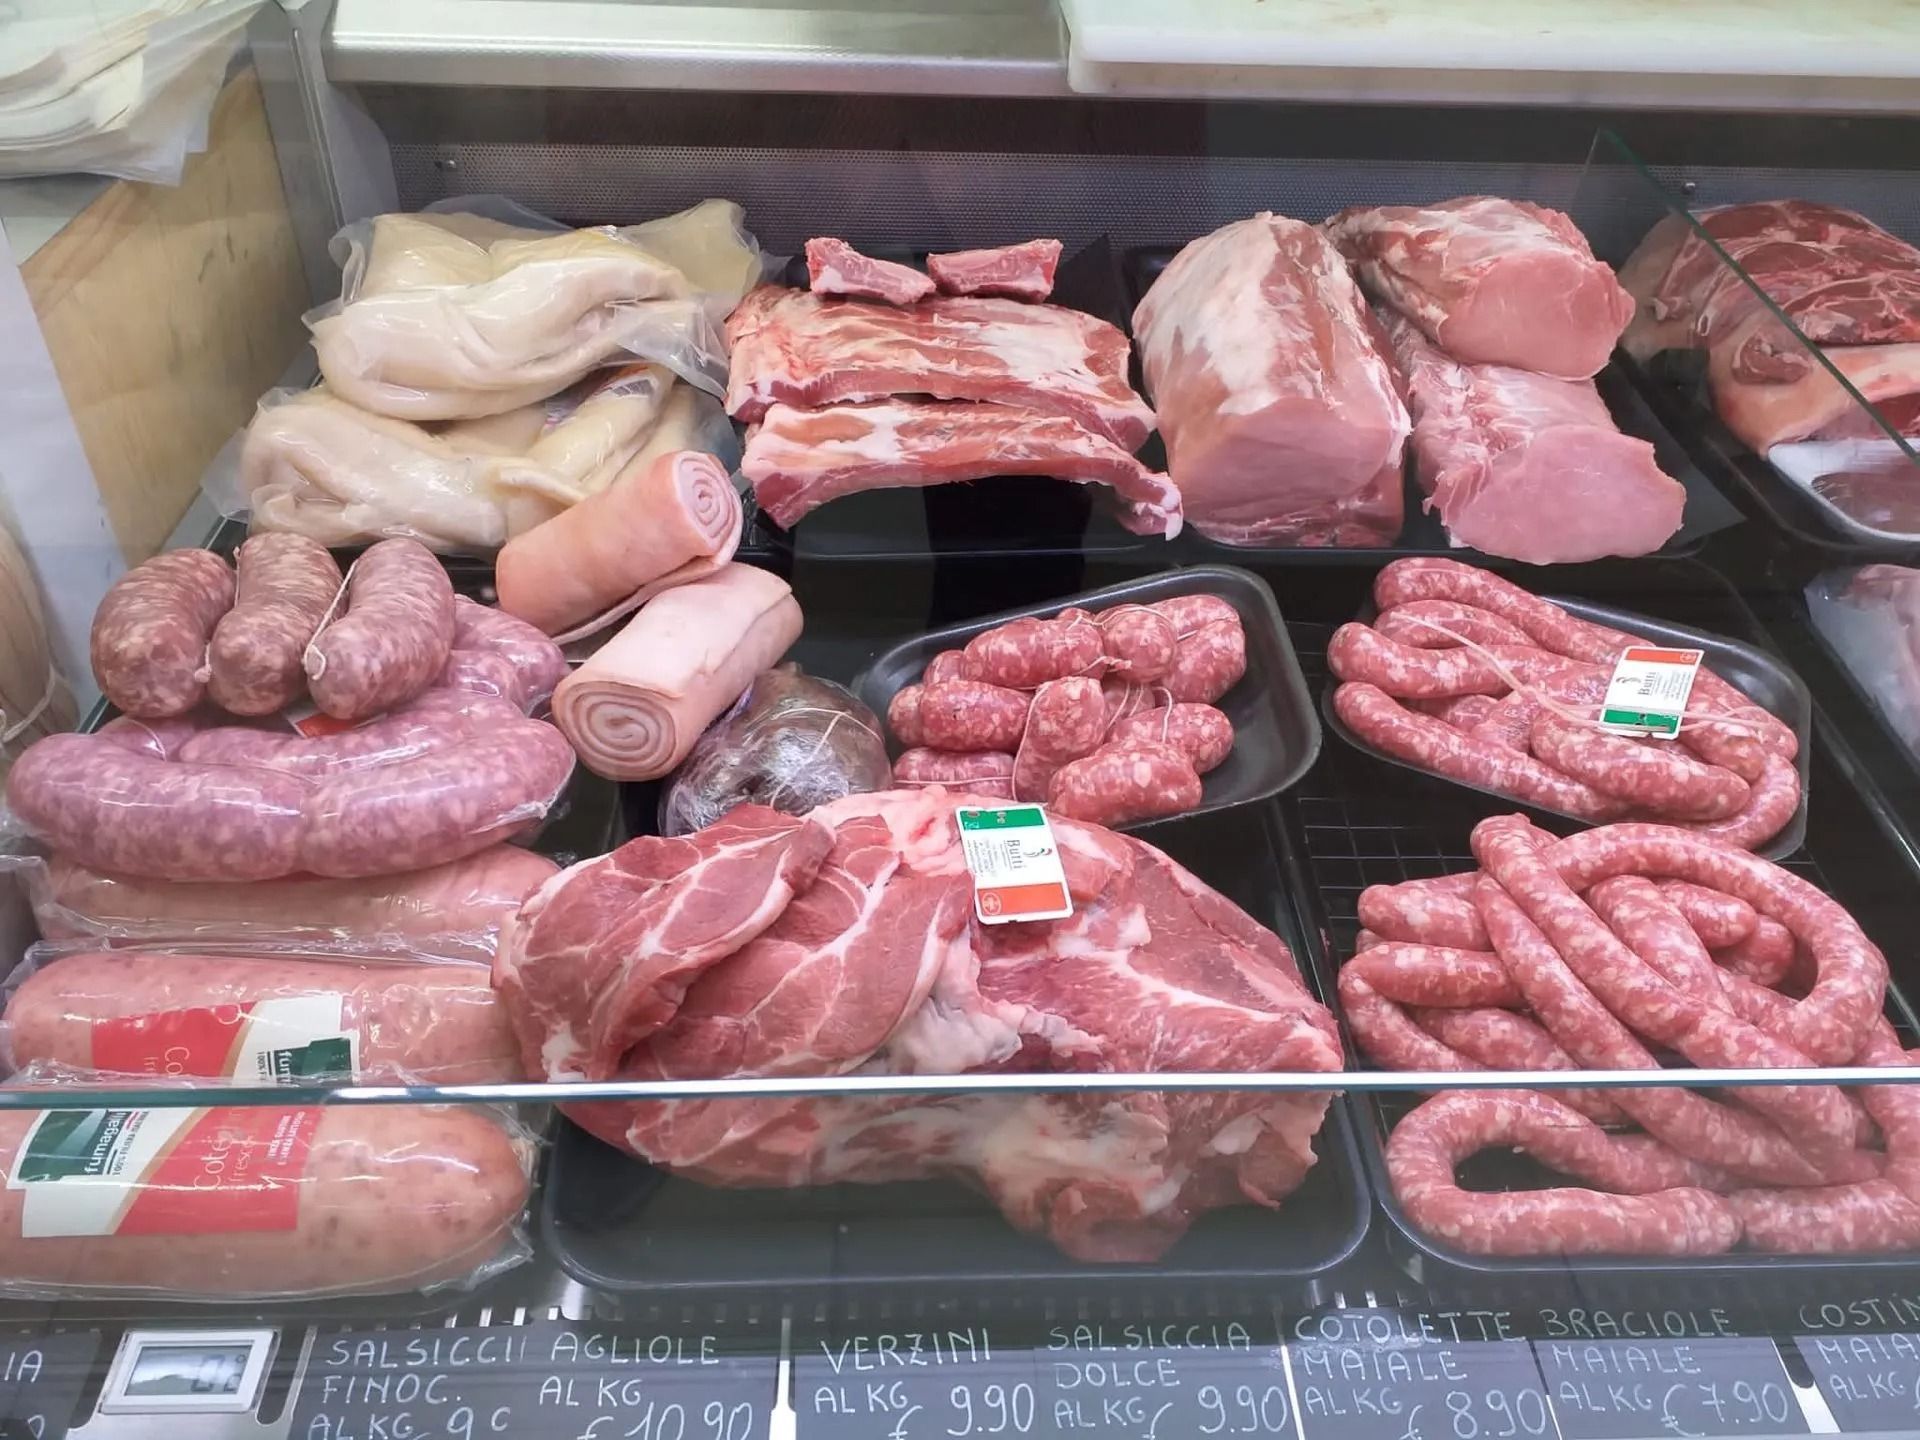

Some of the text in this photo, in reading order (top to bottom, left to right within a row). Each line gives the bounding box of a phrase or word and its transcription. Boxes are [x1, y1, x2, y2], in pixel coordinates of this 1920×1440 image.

[84, 1111, 127, 1173] fumagalli
[1048, 1322, 1250, 1351] SALSICCIA
[1295, 1310, 1527, 1344] COTOLETTE
[1539, 1308, 1740, 1339] BRACIOLE
[551, 1332, 719, 1365] AGLIOLE
[821, 1328, 991, 1374] VERZINI
[1552, 1344, 1701, 1374] MAIALE
[1815, 1332, 1920, 1365] MAIA
[1053, 1358, 1181, 1388] DOLCE
[1303, 1349, 1468, 1382] MAIALE
[322, 1373, 462, 1404] FINOC.
[539, 1376, 580, 1406] AL
[597, 1377, 643, 1407] KG
[814, 1386, 856, 1414] AL
[867, 1381, 909, 1413] KG
[947, 1383, 1035, 1436] 9.90
[1198, 1385, 1288, 1433] 9.90
[1446, 1388, 1546, 1439] 8.90
